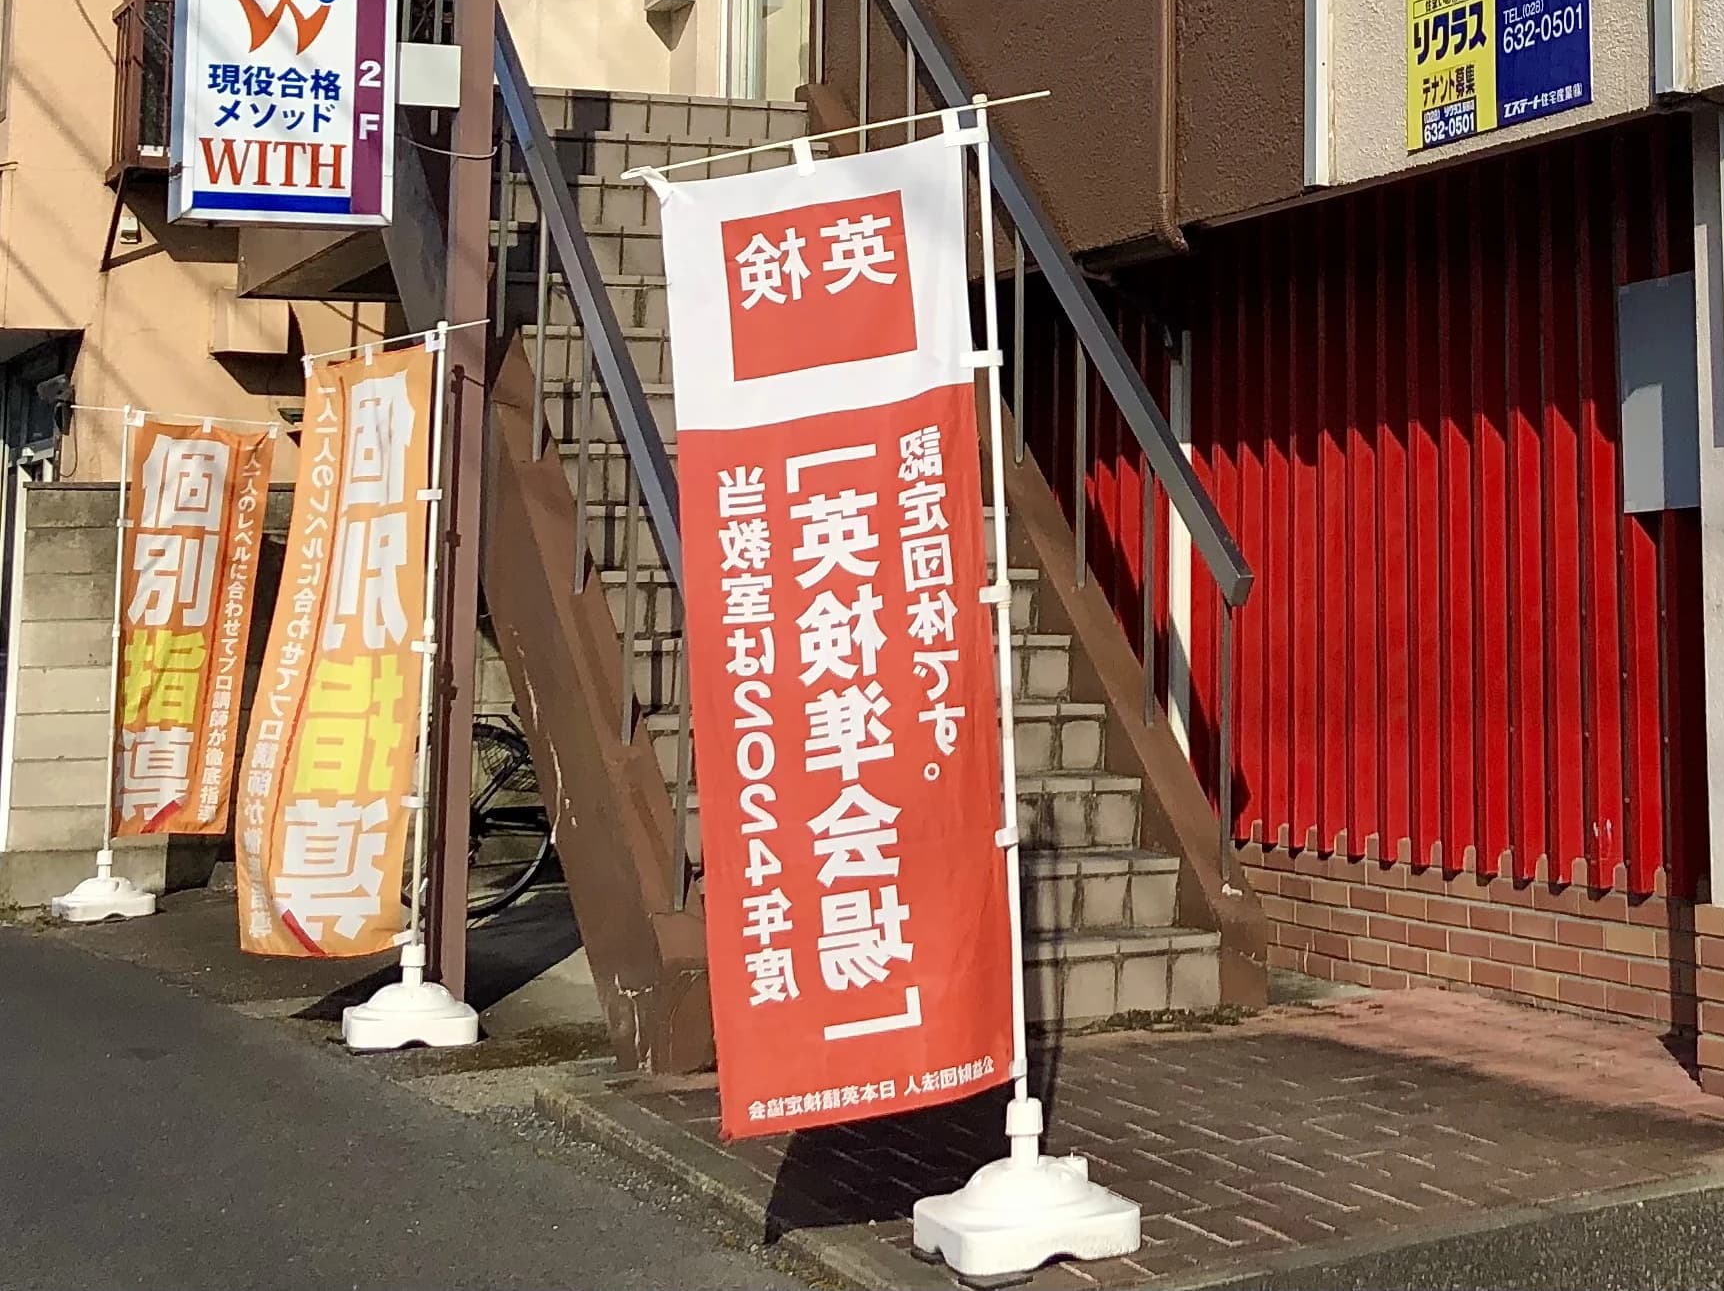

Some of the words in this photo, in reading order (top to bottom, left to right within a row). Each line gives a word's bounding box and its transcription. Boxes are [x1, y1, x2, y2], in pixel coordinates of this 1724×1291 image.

[1413, 1, 1487, 65] リクラス
[1503, 3, 1582, 53] 632-0501
[208, 64, 341, 99] 現役合格
[1422, 63, 1475, 108] テナント募集
[213, 100, 333, 133] メソッド
[1424, 112, 1475, 143] 632-0501
[198, 137, 347, 190] WITH
[118, 434, 230, 822] 個別指導
